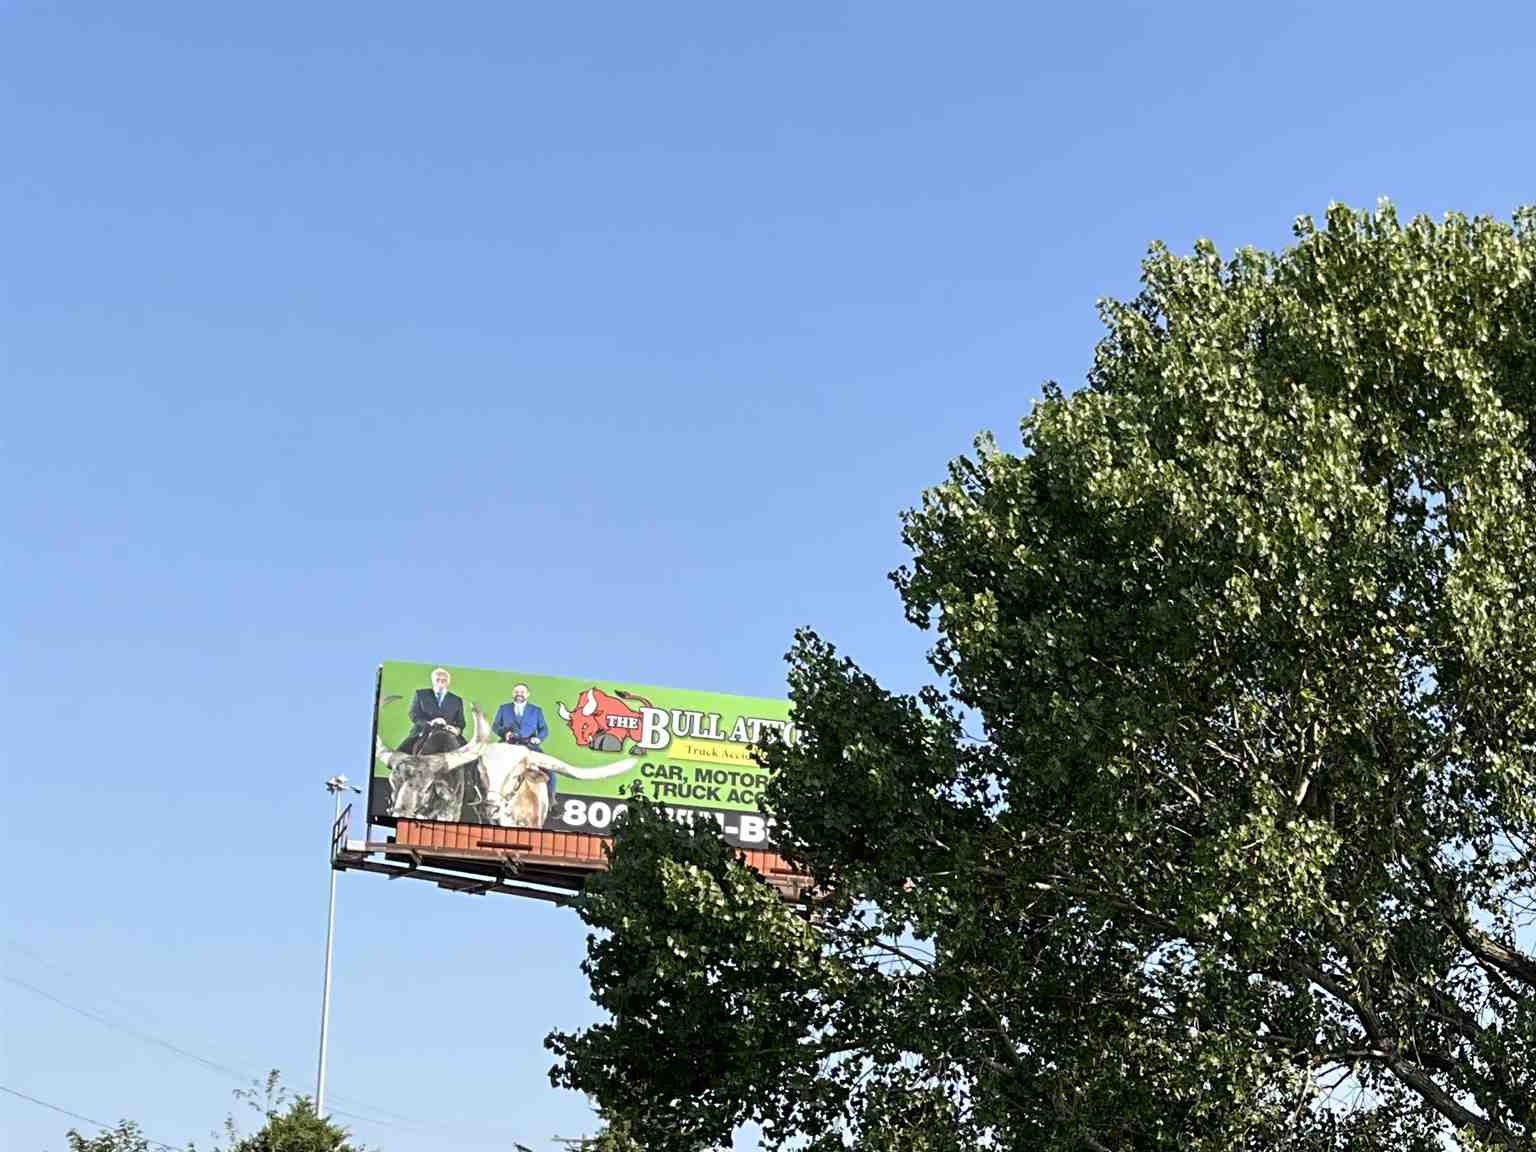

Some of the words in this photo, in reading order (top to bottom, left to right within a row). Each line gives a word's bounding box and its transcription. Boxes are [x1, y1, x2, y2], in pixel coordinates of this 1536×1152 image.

[606, 715, 639, 729] THE
[637, 706, 726, 750] BULL
[687, 744, 719, 757] Truck
[640, 762, 688, 784] CAR,
[651, 780, 722, 801] TRUCK
